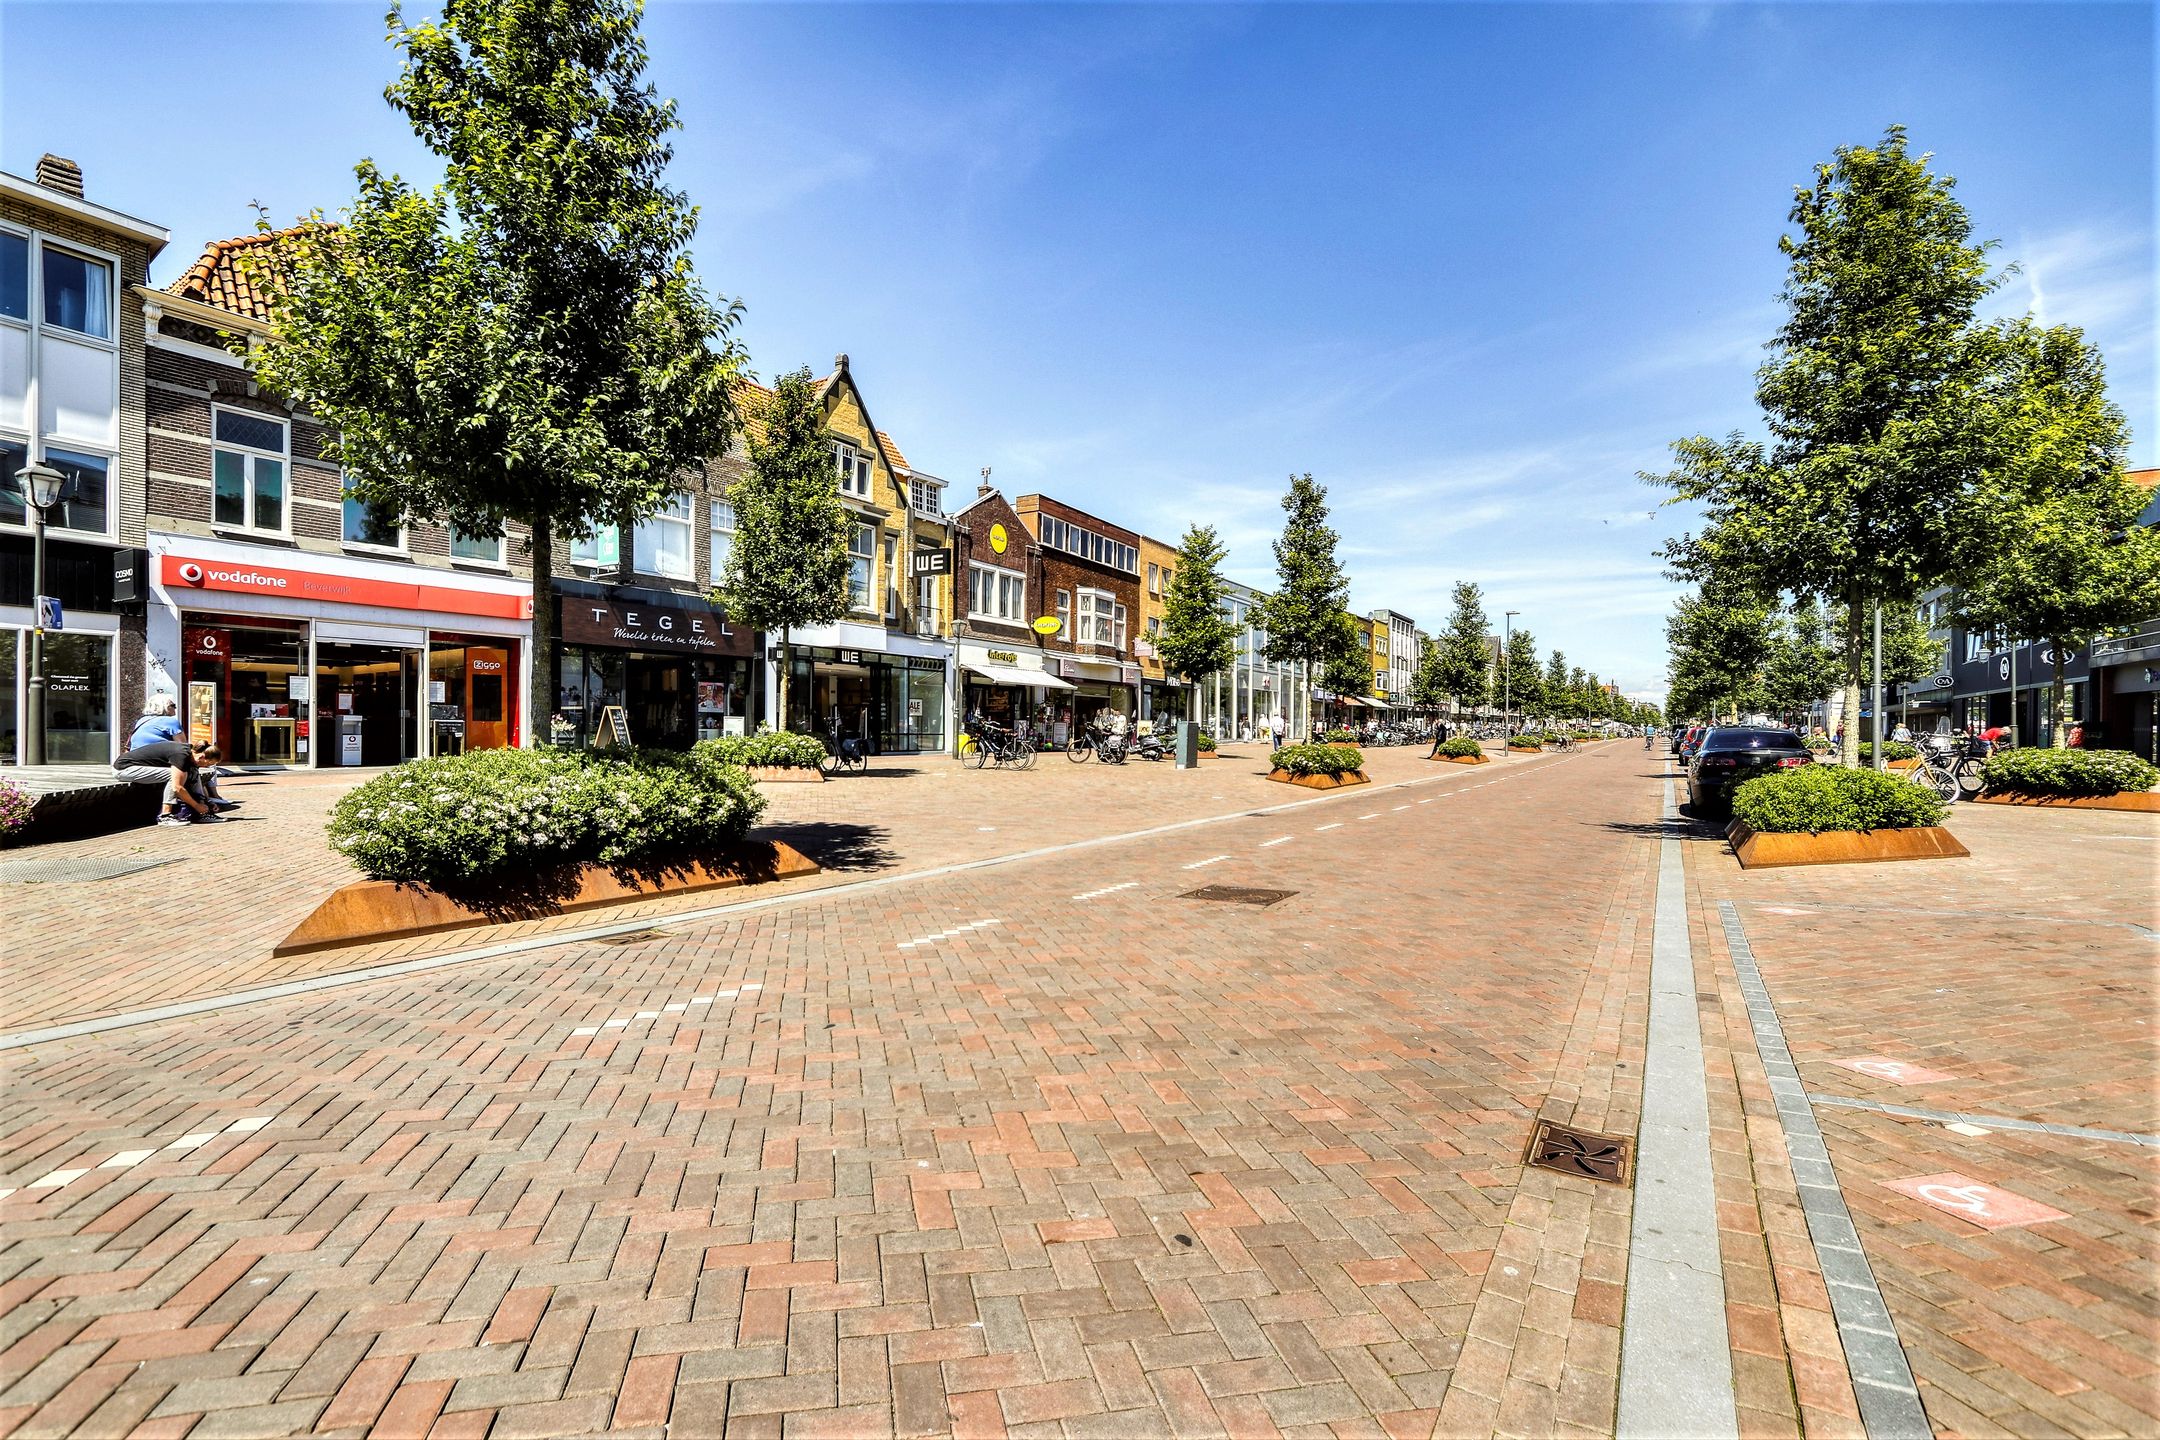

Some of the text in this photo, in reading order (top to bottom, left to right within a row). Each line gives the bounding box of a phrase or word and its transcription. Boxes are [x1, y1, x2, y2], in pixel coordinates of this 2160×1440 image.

[916, 554, 944, 571] WE
[207, 570, 287, 588] vodafone
[591, 608, 734, 636] TEGEL
[612, 627, 649, 640] Werelds
[651, 632, 674, 644] koken
[676, 637, 686, 645] en
[195, 649, 224, 657] vodafone
[841, 650, 859, 663] WE
